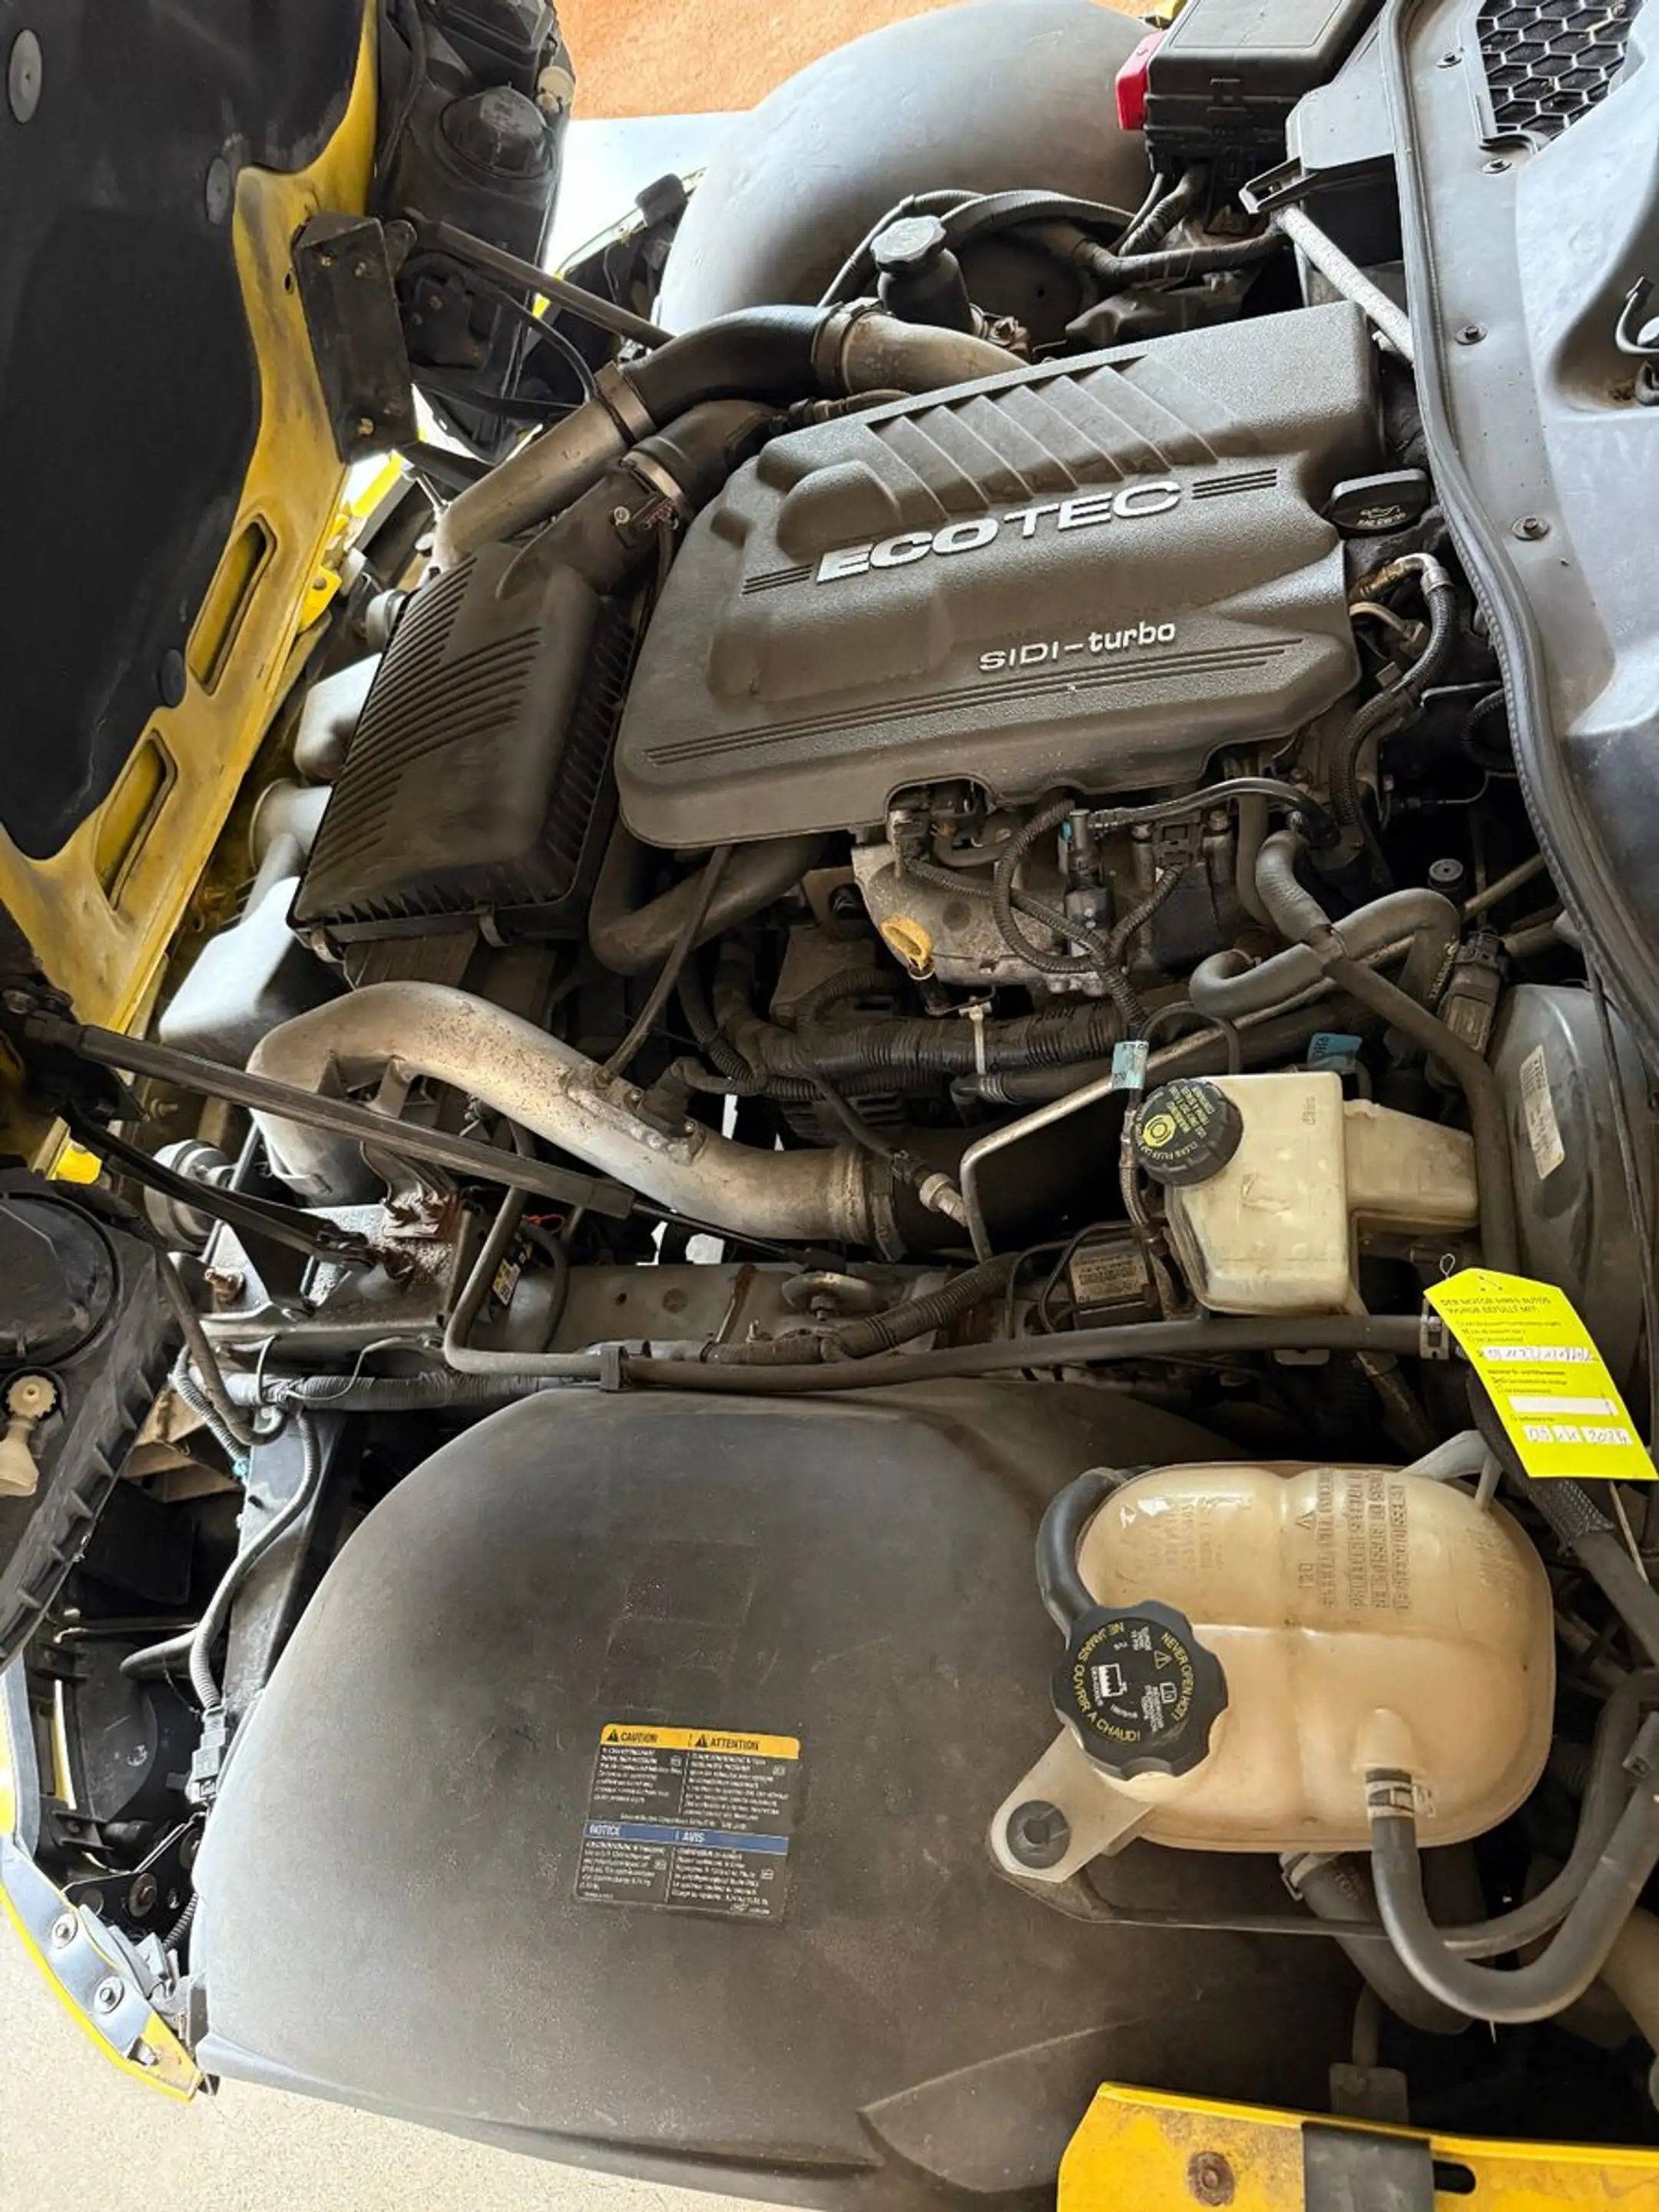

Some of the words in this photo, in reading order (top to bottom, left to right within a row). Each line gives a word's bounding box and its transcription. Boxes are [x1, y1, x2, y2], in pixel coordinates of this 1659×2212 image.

[816, 481, 1181, 584] ECOTEC
[979, 621, 1176, 671] SIDI-turbo
[1161, 1632, 1189, 1665] NEVER
[1181, 1665, 1194, 1694] OPEN
[1073, 1665, 1091, 1713] OUVRIR
[1096, 1717, 1141, 1742] CHAUD!
[620, 1731, 657, 1743] CAUTION
[710, 1737, 759, 1751] ATTENTION
[589, 1823, 620, 1836] NOTICE
[681, 1830, 704, 1843] AVIS
